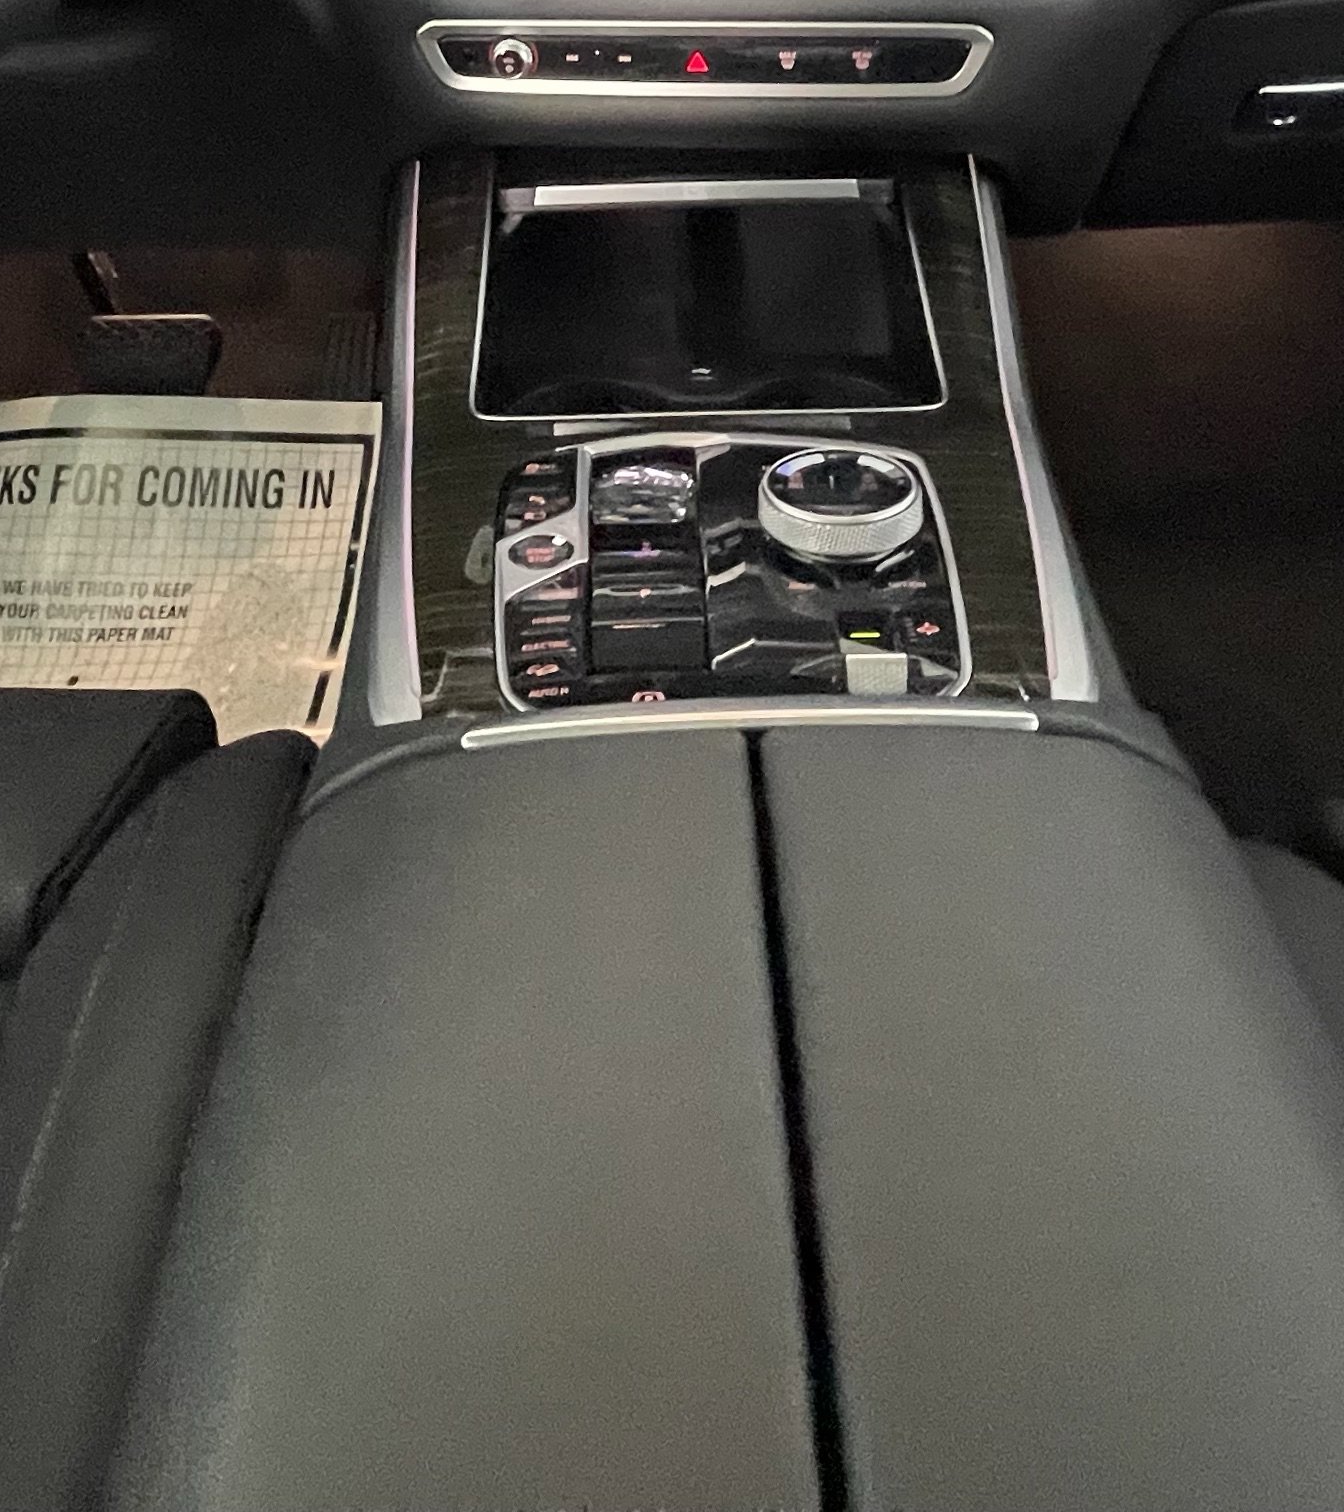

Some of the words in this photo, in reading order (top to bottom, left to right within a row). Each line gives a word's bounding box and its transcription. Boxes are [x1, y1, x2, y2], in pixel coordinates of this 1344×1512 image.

[50, 464, 124, 505] FOR
[136, 465, 286, 509] COMING
[298, 469, 335, 509] IN
[2, 580, 26, 595] WE
[30, 580, 73, 597] HAVE
[77, 581, 125, 598] TRIED
[129, 582, 149, 598] TO
[152, 582, 193, 598] KEEP
[45, 603, 133, 621] CARPETING
[138, 604, 189, 620] CLEAN
[2, 626, 43, 642] WITH
[47, 626, 85, 642] THIS
[86, 626, 139, 643] PAPER
[141, 626, 175, 641] MAT
